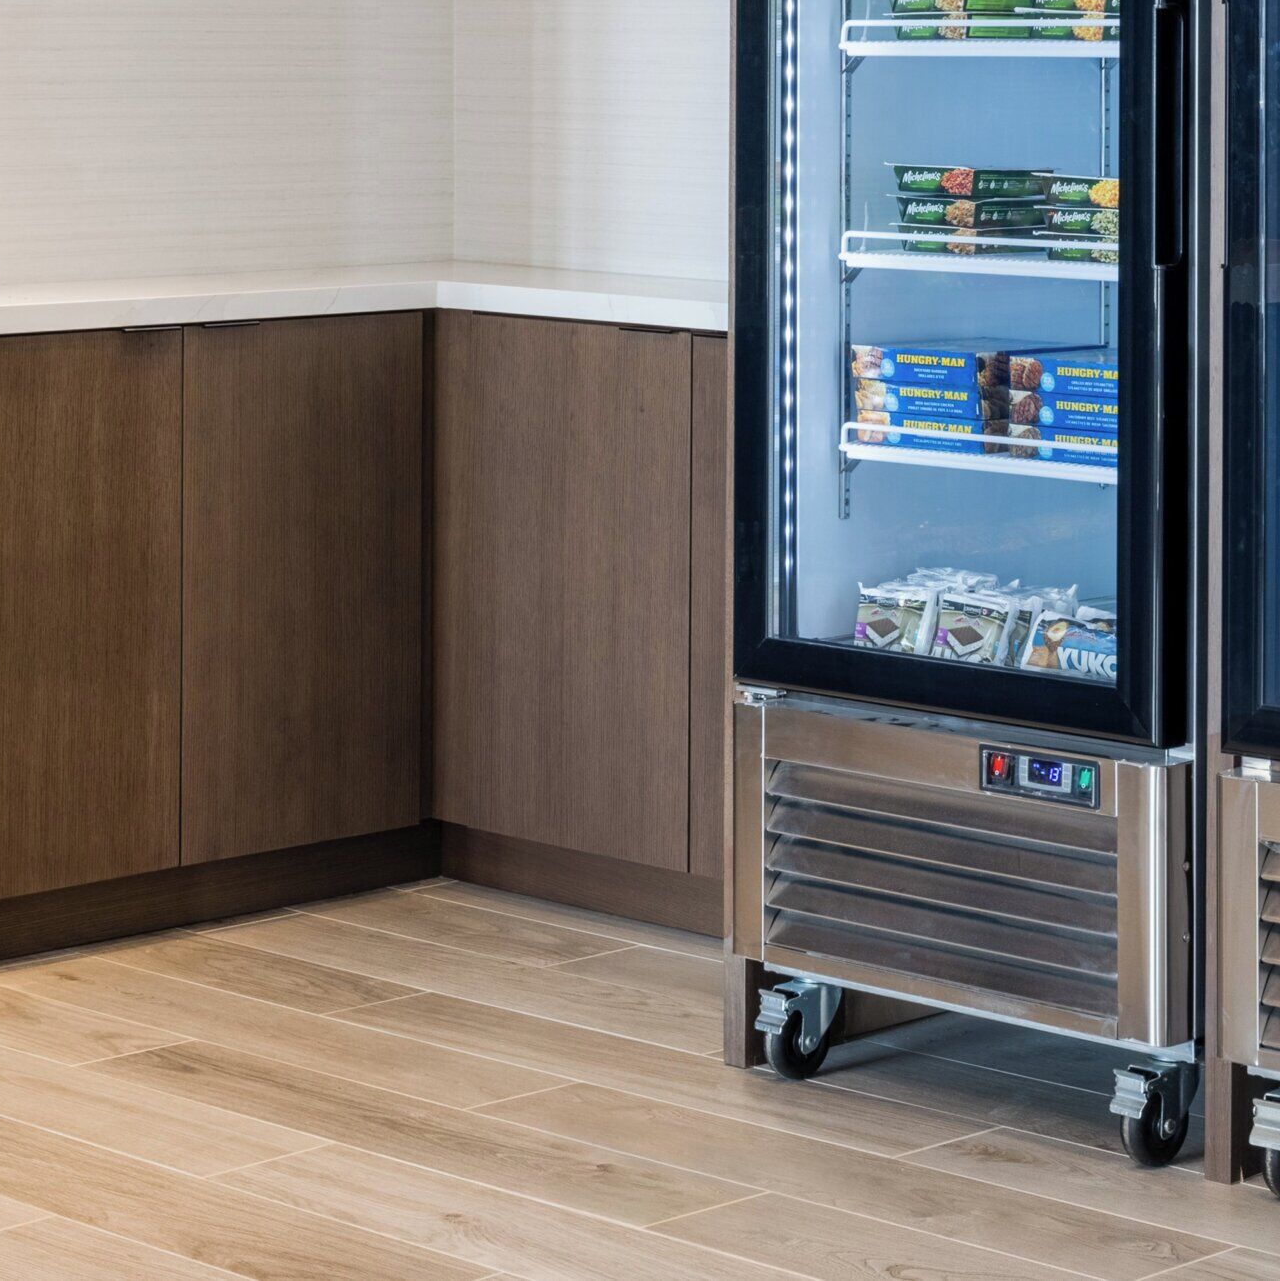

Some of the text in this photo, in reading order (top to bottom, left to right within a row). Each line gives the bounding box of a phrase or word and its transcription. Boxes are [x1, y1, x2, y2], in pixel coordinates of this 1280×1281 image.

[902, 170, 941, 184] Michelina's
[1050, 181, 1089, 195] Michelina's
[907, 202, 944, 215] Michelina's
[1052, 211, 1091, 225] Michelina's
[1057, 366, 1118, 379] HUNGRY-MA
[1056, 400, 1118, 415] HUNGRY-MA
[1055, 434, 1118, 448] HUNGRY-MA
